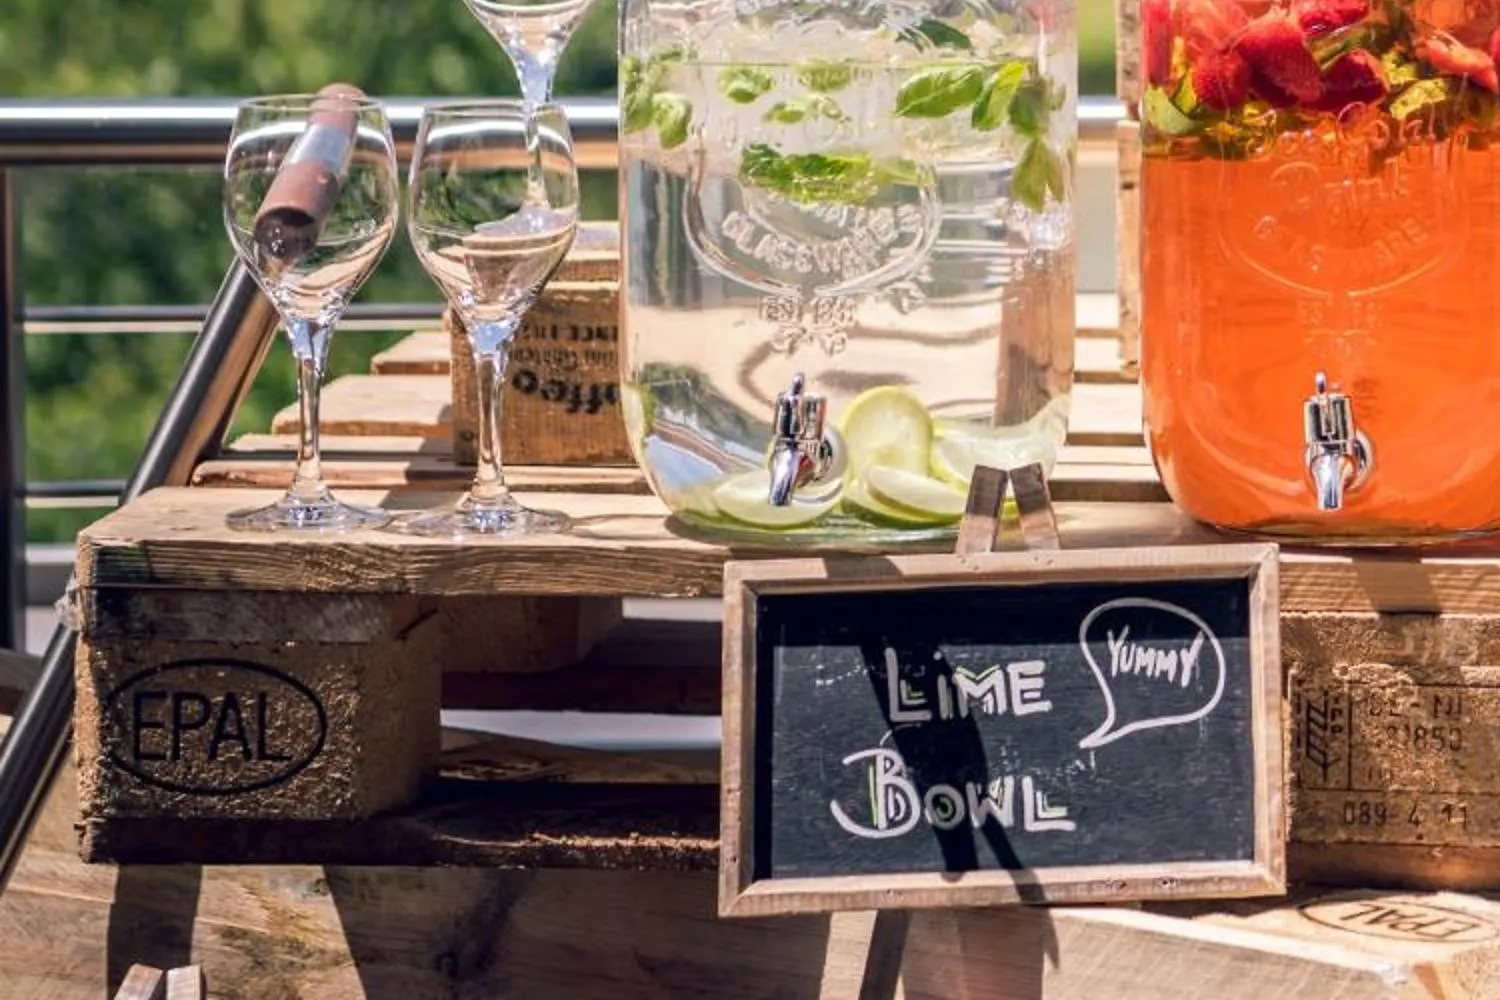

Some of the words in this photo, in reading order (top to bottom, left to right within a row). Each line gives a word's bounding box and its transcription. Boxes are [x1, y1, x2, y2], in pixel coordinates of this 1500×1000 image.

[1107, 624, 1204, 688] YUMMY
[132, 691, 292, 762] EPAL
[830, 747, 1076, 839] BOWL
